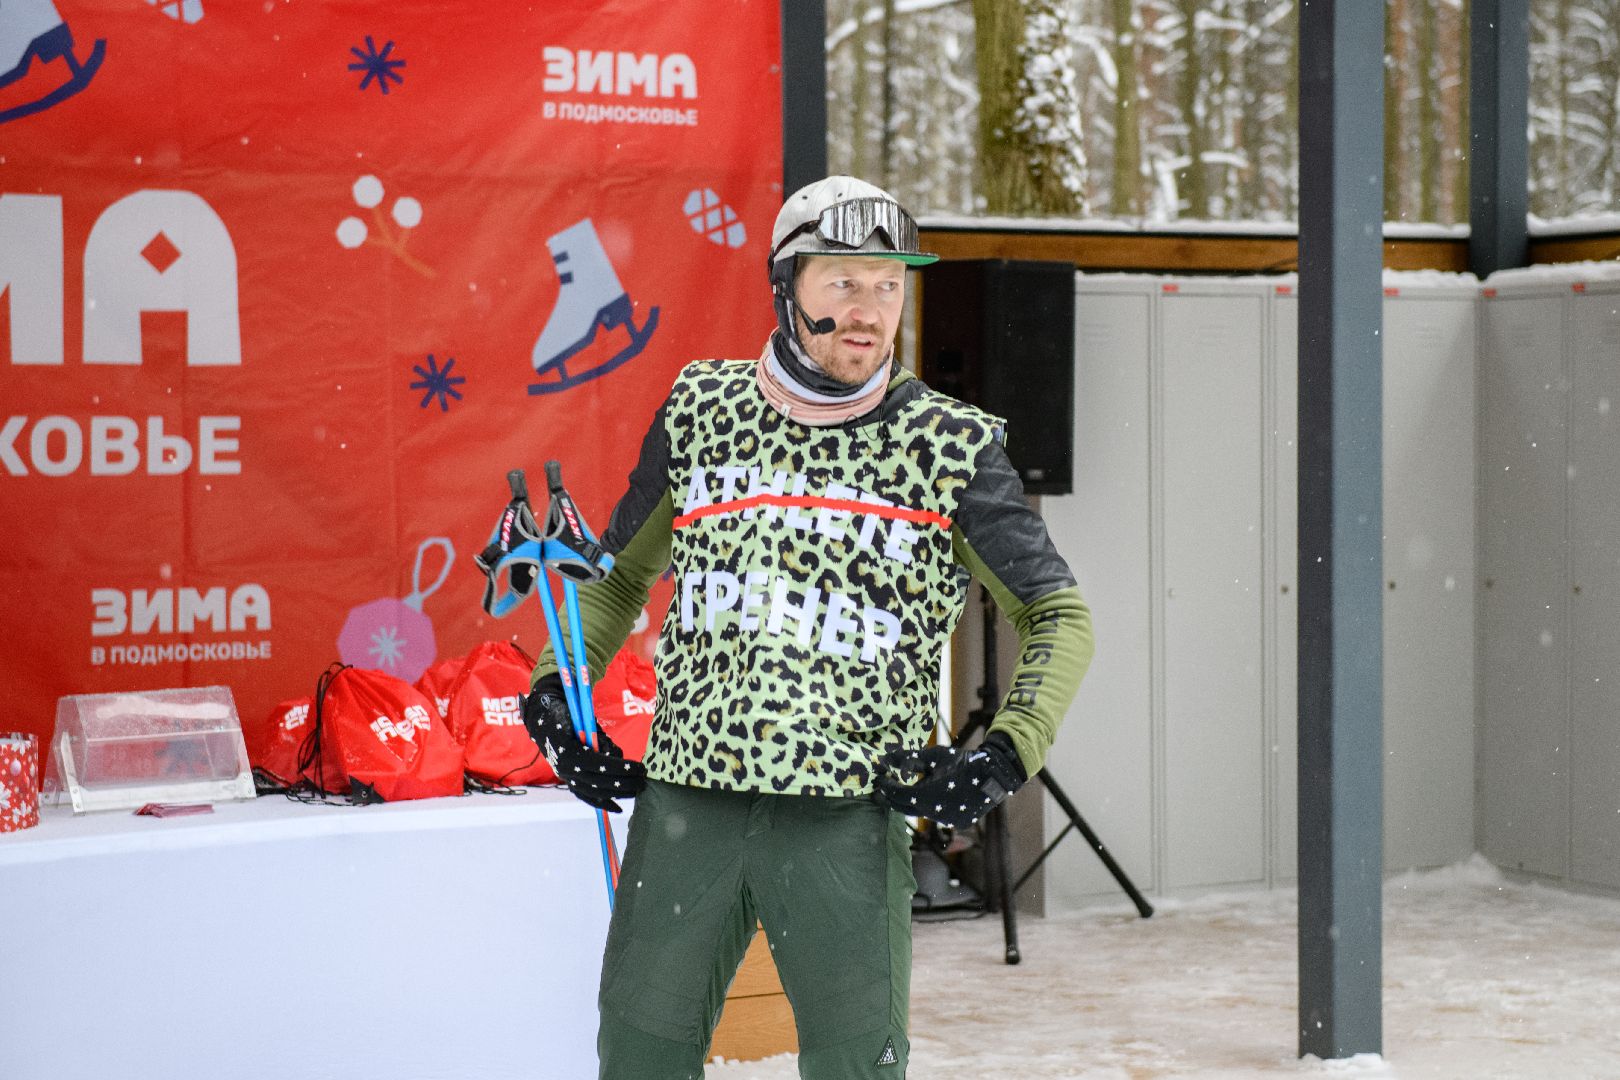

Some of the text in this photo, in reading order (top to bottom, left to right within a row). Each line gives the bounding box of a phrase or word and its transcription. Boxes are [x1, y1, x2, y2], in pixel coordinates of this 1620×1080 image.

[542, 46, 698, 99] ЗИМА
[543, 102, 698, 126] В ПОДМОСКОВЬЕ
[682, 466, 920, 565] ATHLETE
[91, 583, 272, 637] ЗИМА
[91, 640, 272, 667] В ПОДМОСКОВЬЕ
